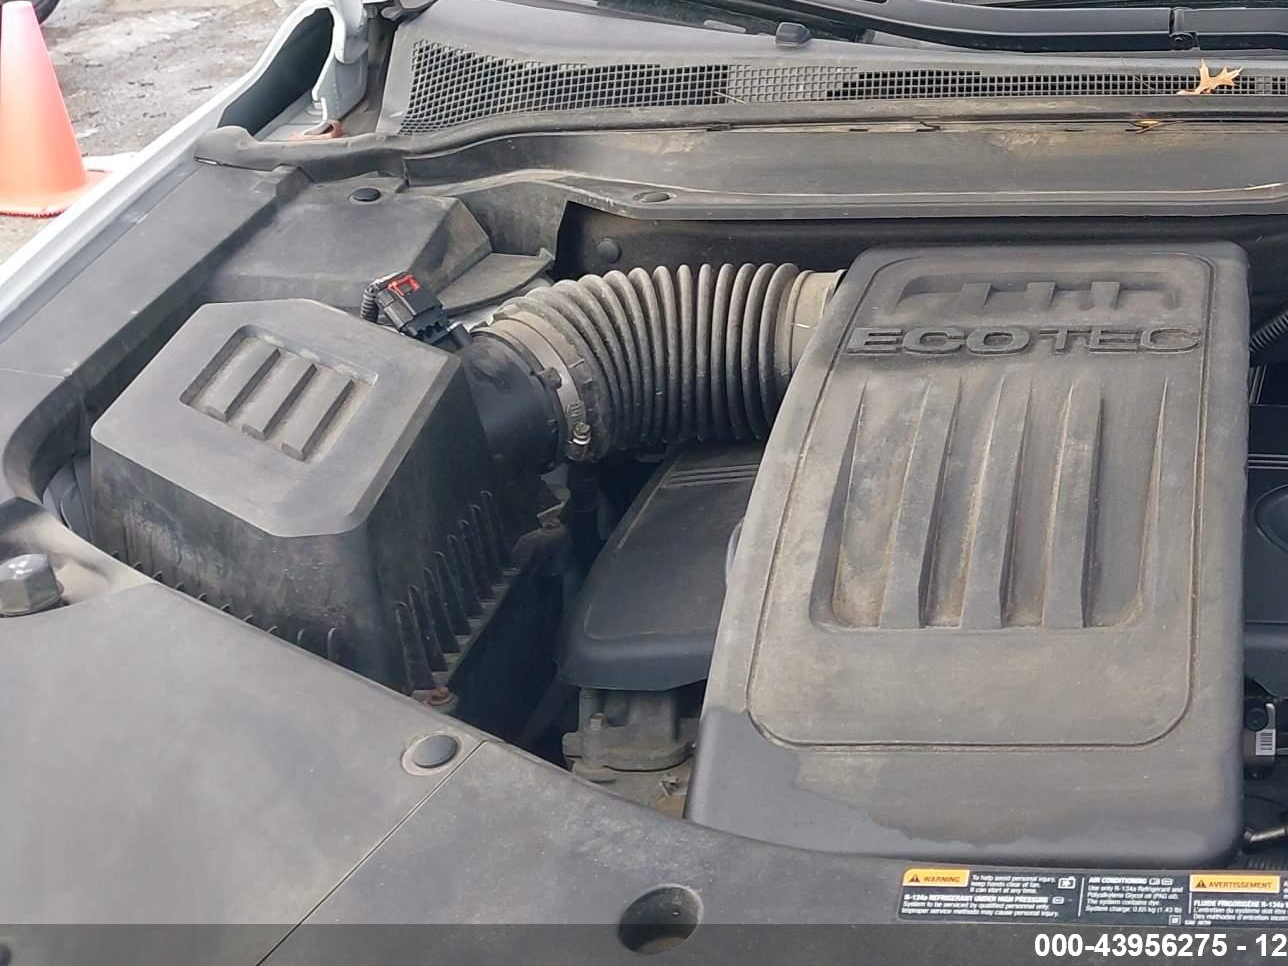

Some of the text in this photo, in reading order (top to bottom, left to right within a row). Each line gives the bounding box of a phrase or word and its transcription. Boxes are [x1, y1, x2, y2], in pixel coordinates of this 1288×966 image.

[846, 326, 1202, 356] ECOTEC
[1012, 875, 1037, 883] personal
[1208, 881, 1272, 889] AVERTISSEMENT
[903, 901, 925, 909] System
